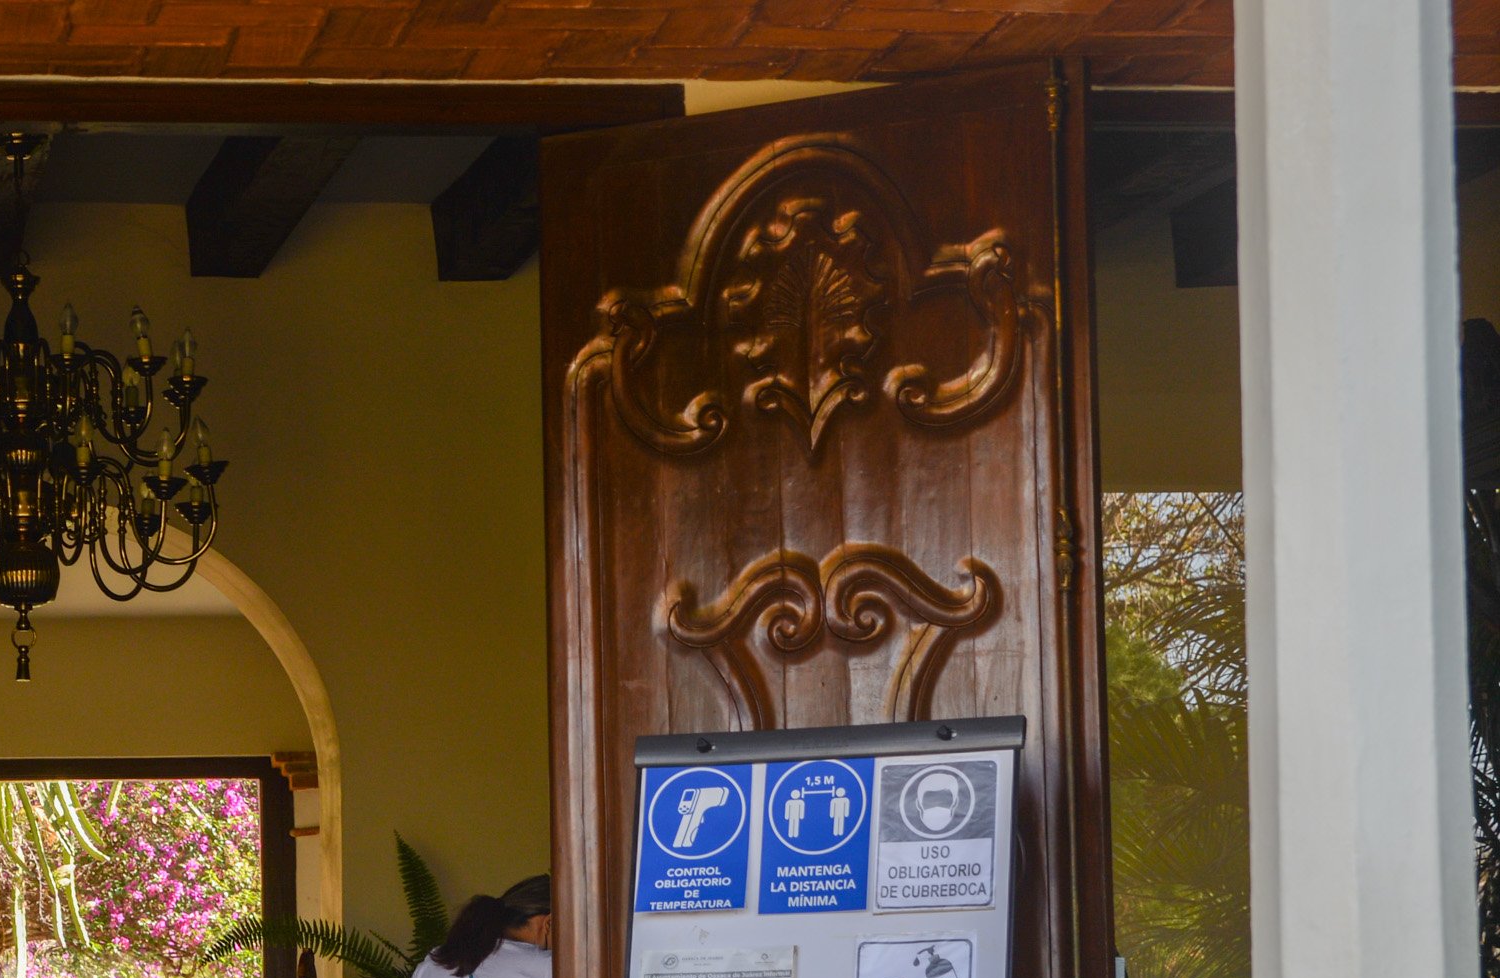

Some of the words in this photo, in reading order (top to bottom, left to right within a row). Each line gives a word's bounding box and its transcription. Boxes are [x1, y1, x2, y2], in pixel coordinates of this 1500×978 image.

[805, 776, 821, 786] 1,5
[824, 775, 835, 785] M
[920, 845, 951, 860] USO
[666, 866, 722, 877] CONTROL
[777, 864, 851, 878] MANTENGA
[888, 862, 982, 879] OBLIGATORIO
[654, 876, 732, 889] OBLIGATORIO
[770, 881, 787, 893] LA
[790, 878, 856, 892] DISTANCIA
[683, 889, 700, 899] DE
[880, 885, 898, 898] DE
[901, 882, 987, 898] CUBREBOCA
[649, 899, 732, 911] TEMPERATURA
[787, 894, 838, 908] MÍNIMA
